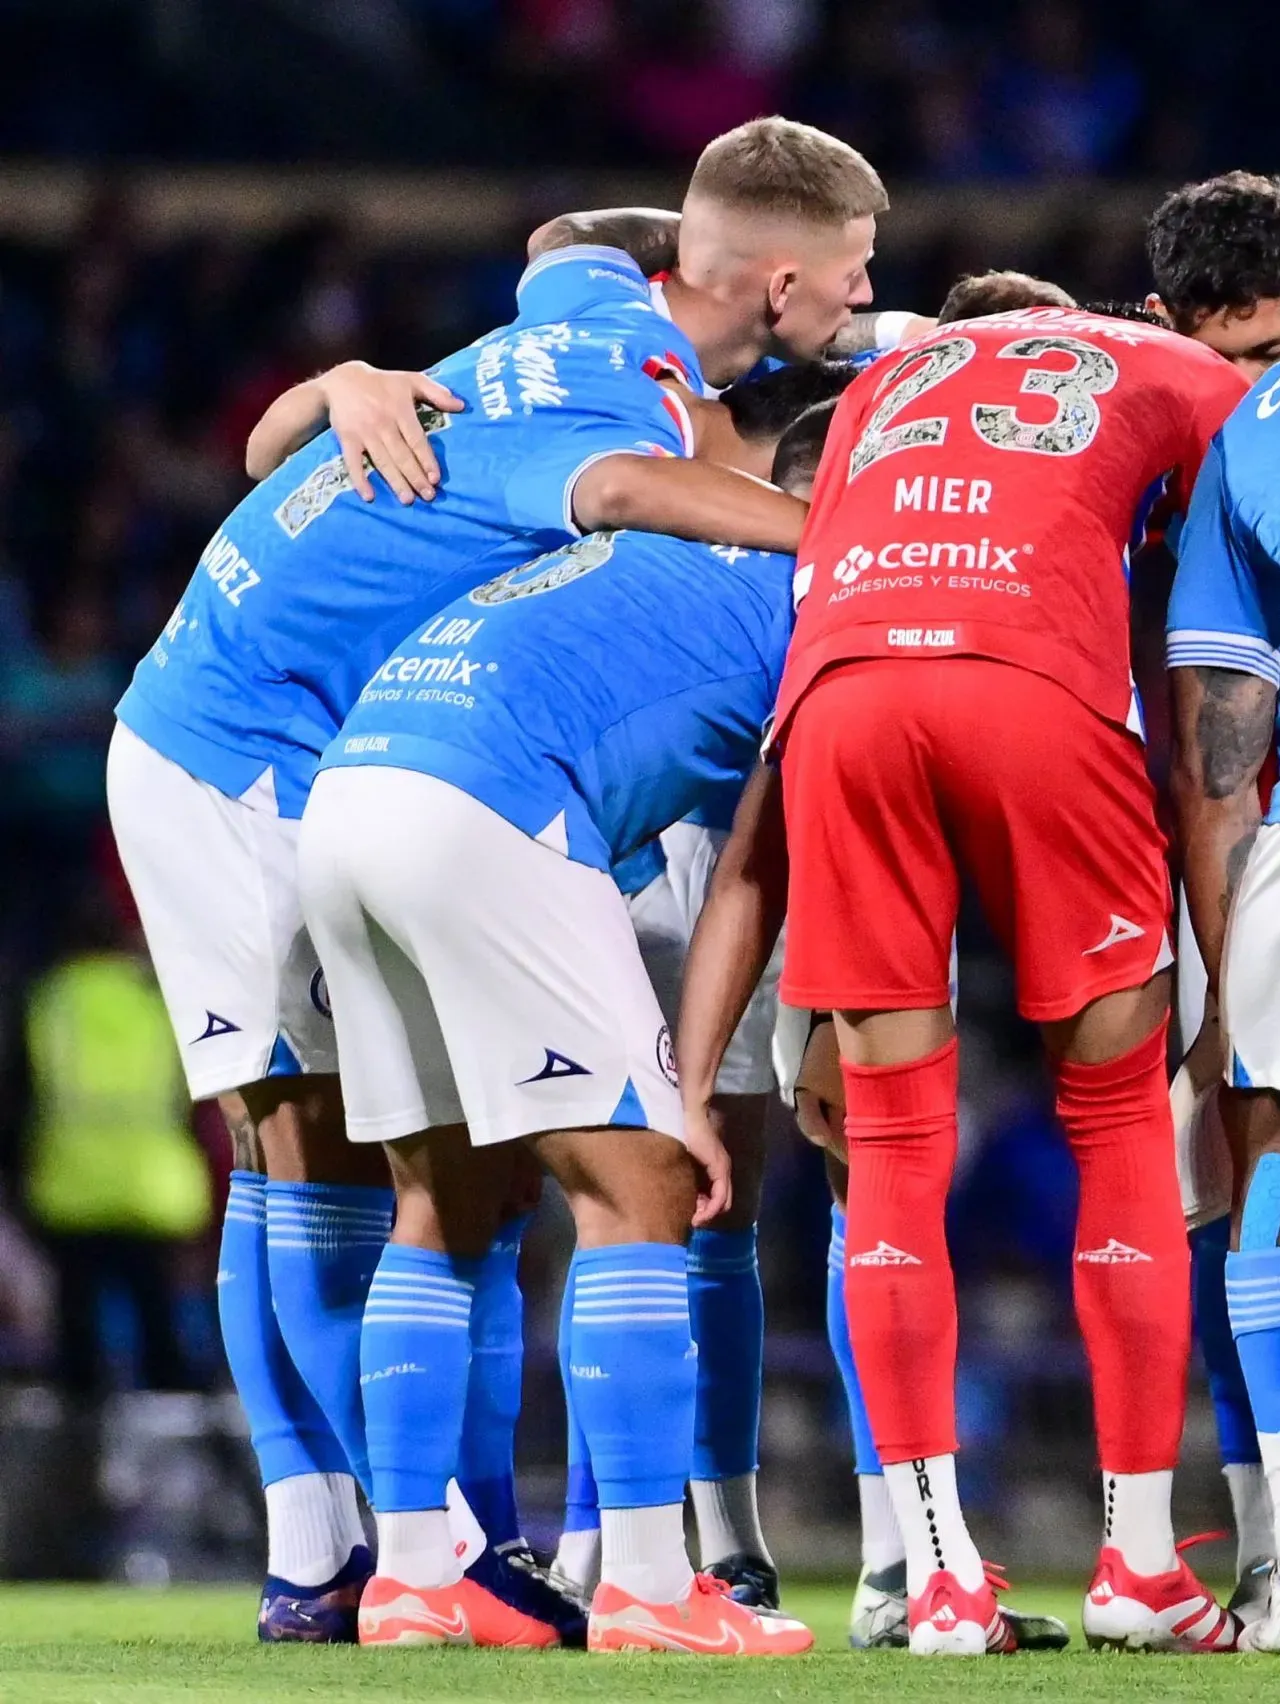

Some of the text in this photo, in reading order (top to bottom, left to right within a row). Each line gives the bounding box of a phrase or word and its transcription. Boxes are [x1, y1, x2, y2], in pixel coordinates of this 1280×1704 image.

[847, 336, 1119, 484] 23
[894, 476, 992, 514] MIER
[877, 537, 1019, 573] cemix
[828, 575, 1033, 606] ADHESIVOS Y ESTUCOS
[418, 616, 485, 645] LIRA
[887, 628, 956, 647] CRUZ AZUL
[380, 650, 482, 686] cemix
[405, 689, 414, 701] Y
[415, 688, 476, 710] ESTUCOS
